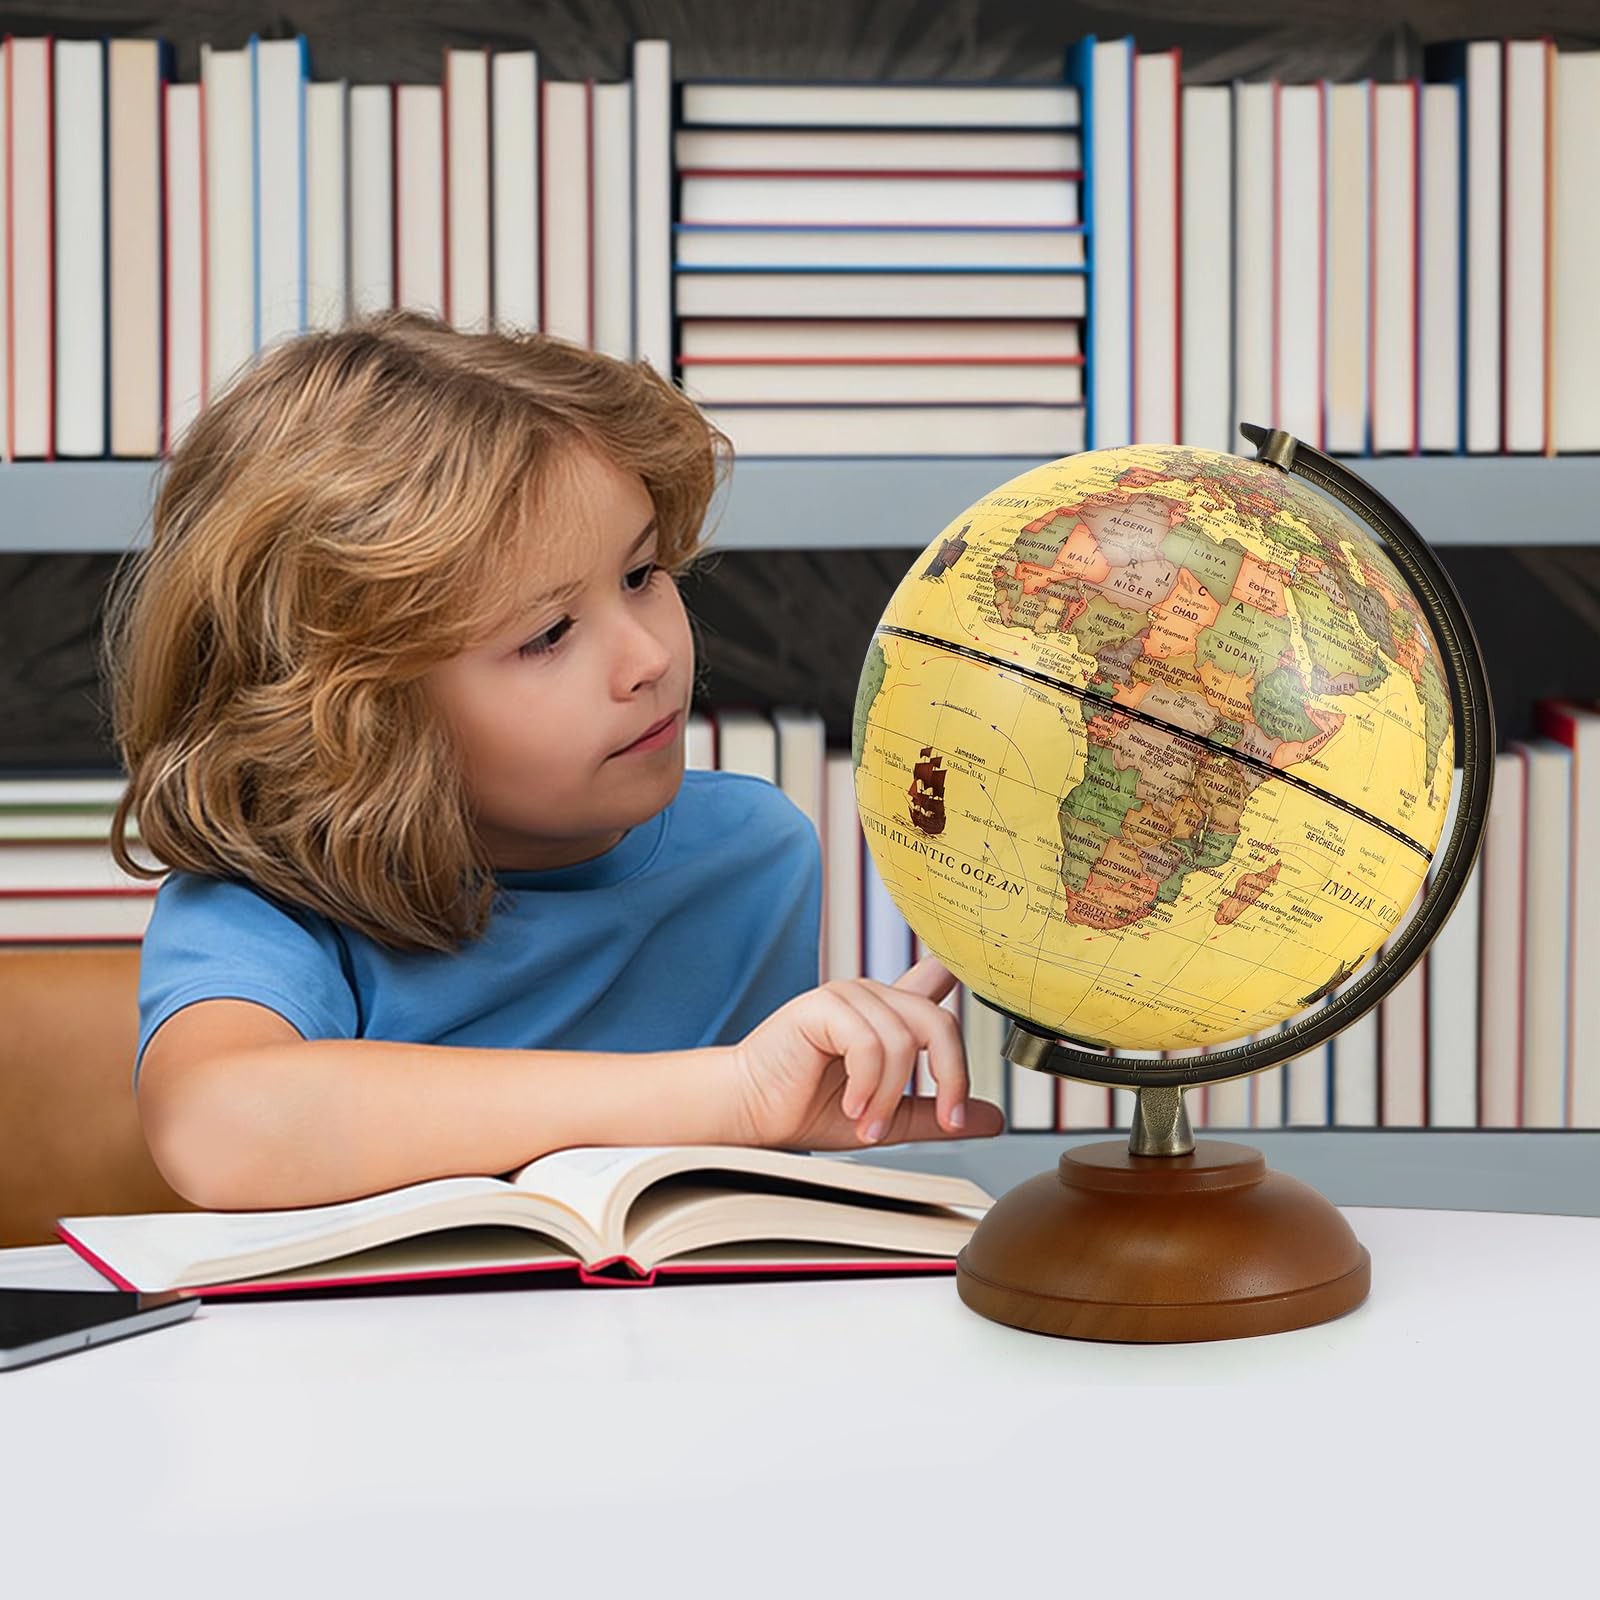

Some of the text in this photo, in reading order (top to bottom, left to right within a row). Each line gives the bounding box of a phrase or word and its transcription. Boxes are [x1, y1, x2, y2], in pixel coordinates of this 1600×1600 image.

[1077, 491, 1114, 503] MOROCCO
[1110, 517, 1153, 534] ALGERIA
[1067, 552, 1095, 566] MALI
[1194, 549, 1227, 566] LIBYA
[1113, 580, 1153, 599] NIGER
[1248, 581, 1275, 598] EGYPT
[1321, 584, 1345, 601] IRAQ
[1022, 600, 1040, 611] CÔTE
[1171, 605, 1199, 622] CHAD
[1095, 613, 1126, 631] NIGERIA
[1229, 630, 1260, 649] Khartoum
[1300, 622, 1348, 651] SAUDI ARABIA
[1217, 640, 1257, 664] SUDAN
[1139, 655, 1201, 684] CENTRAL AFRICAN
[1148, 668, 1183, 686] REPUBLIC
[1325, 682, 1354, 692] YEMEN
[1203, 685, 1253, 713] SOUTH SUDAN
[1103, 715, 1130, 731] CONGO
[1260, 709, 1303, 734] ETHIOPIA
[1172, 737, 1203, 755] RWANDA
[1307, 724, 1339, 752] SOMALIA
[955, 746, 986, 766] Jamestown
[1075, 749, 1098, 762] Luanda
[1128, 734, 1162, 754] DEMOCRATIC
[1163, 750, 1189, 768] REPUBLIC
[1145, 749, 1174, 768] OF CONGO
[1243, 741, 1273, 760] KENYA
[1088, 775, 1121, 793] ANGOLA
[1204, 778, 1241, 800] TANZANIA
[1139, 816, 1173, 836] ZAMBIA
[1065, 831, 1101, 852] NAMIBIA
[1246, 837, 1280, 857] COMOROS
[1305, 830, 1346, 857] SEYCHELLES
[889, 829, 957, 869] ATLANTIC
[960, 862, 1025, 897] OCEAN
[1096, 857, 1142, 880] BOTSWANA
[1139, 849, 1181, 872] ZIMBABWE
[1089, 866, 1122, 883] Gaborone
[1130, 883, 1155, 897] Pretoria
[1219, 887, 1270, 911] MADAGASCAR
[1076, 900, 1107, 918] SOUTH
[1321, 878, 1401, 925] INDIAN OCEA
[1071, 907, 1106, 924] AFRICA
[1291, 904, 1323, 923] MAURITIUS
